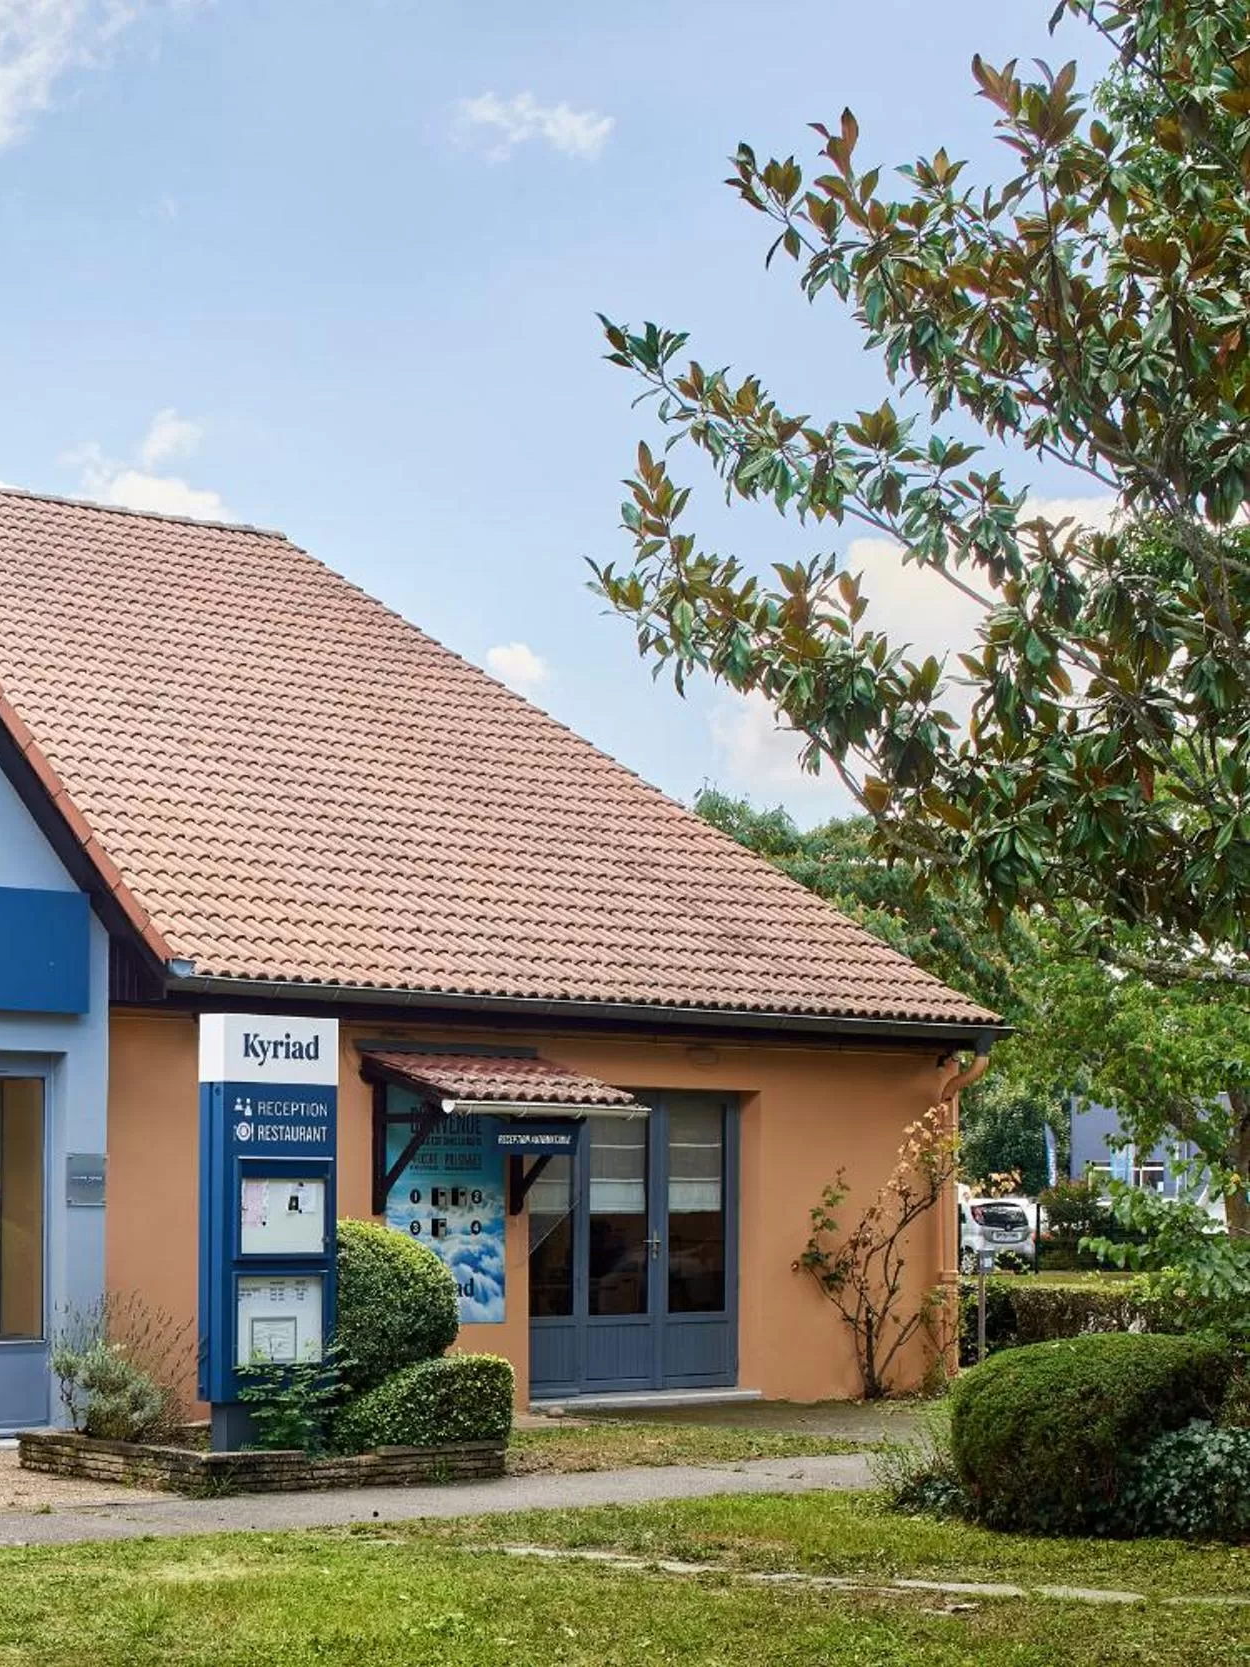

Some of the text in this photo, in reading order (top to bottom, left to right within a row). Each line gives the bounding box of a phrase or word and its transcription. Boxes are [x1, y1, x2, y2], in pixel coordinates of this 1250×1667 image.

[243, 1032, 319, 1066] Kyriad
[257, 1101, 327, 1117] RECEPTION
[257, 1125, 327, 1142] RESTAURANT
